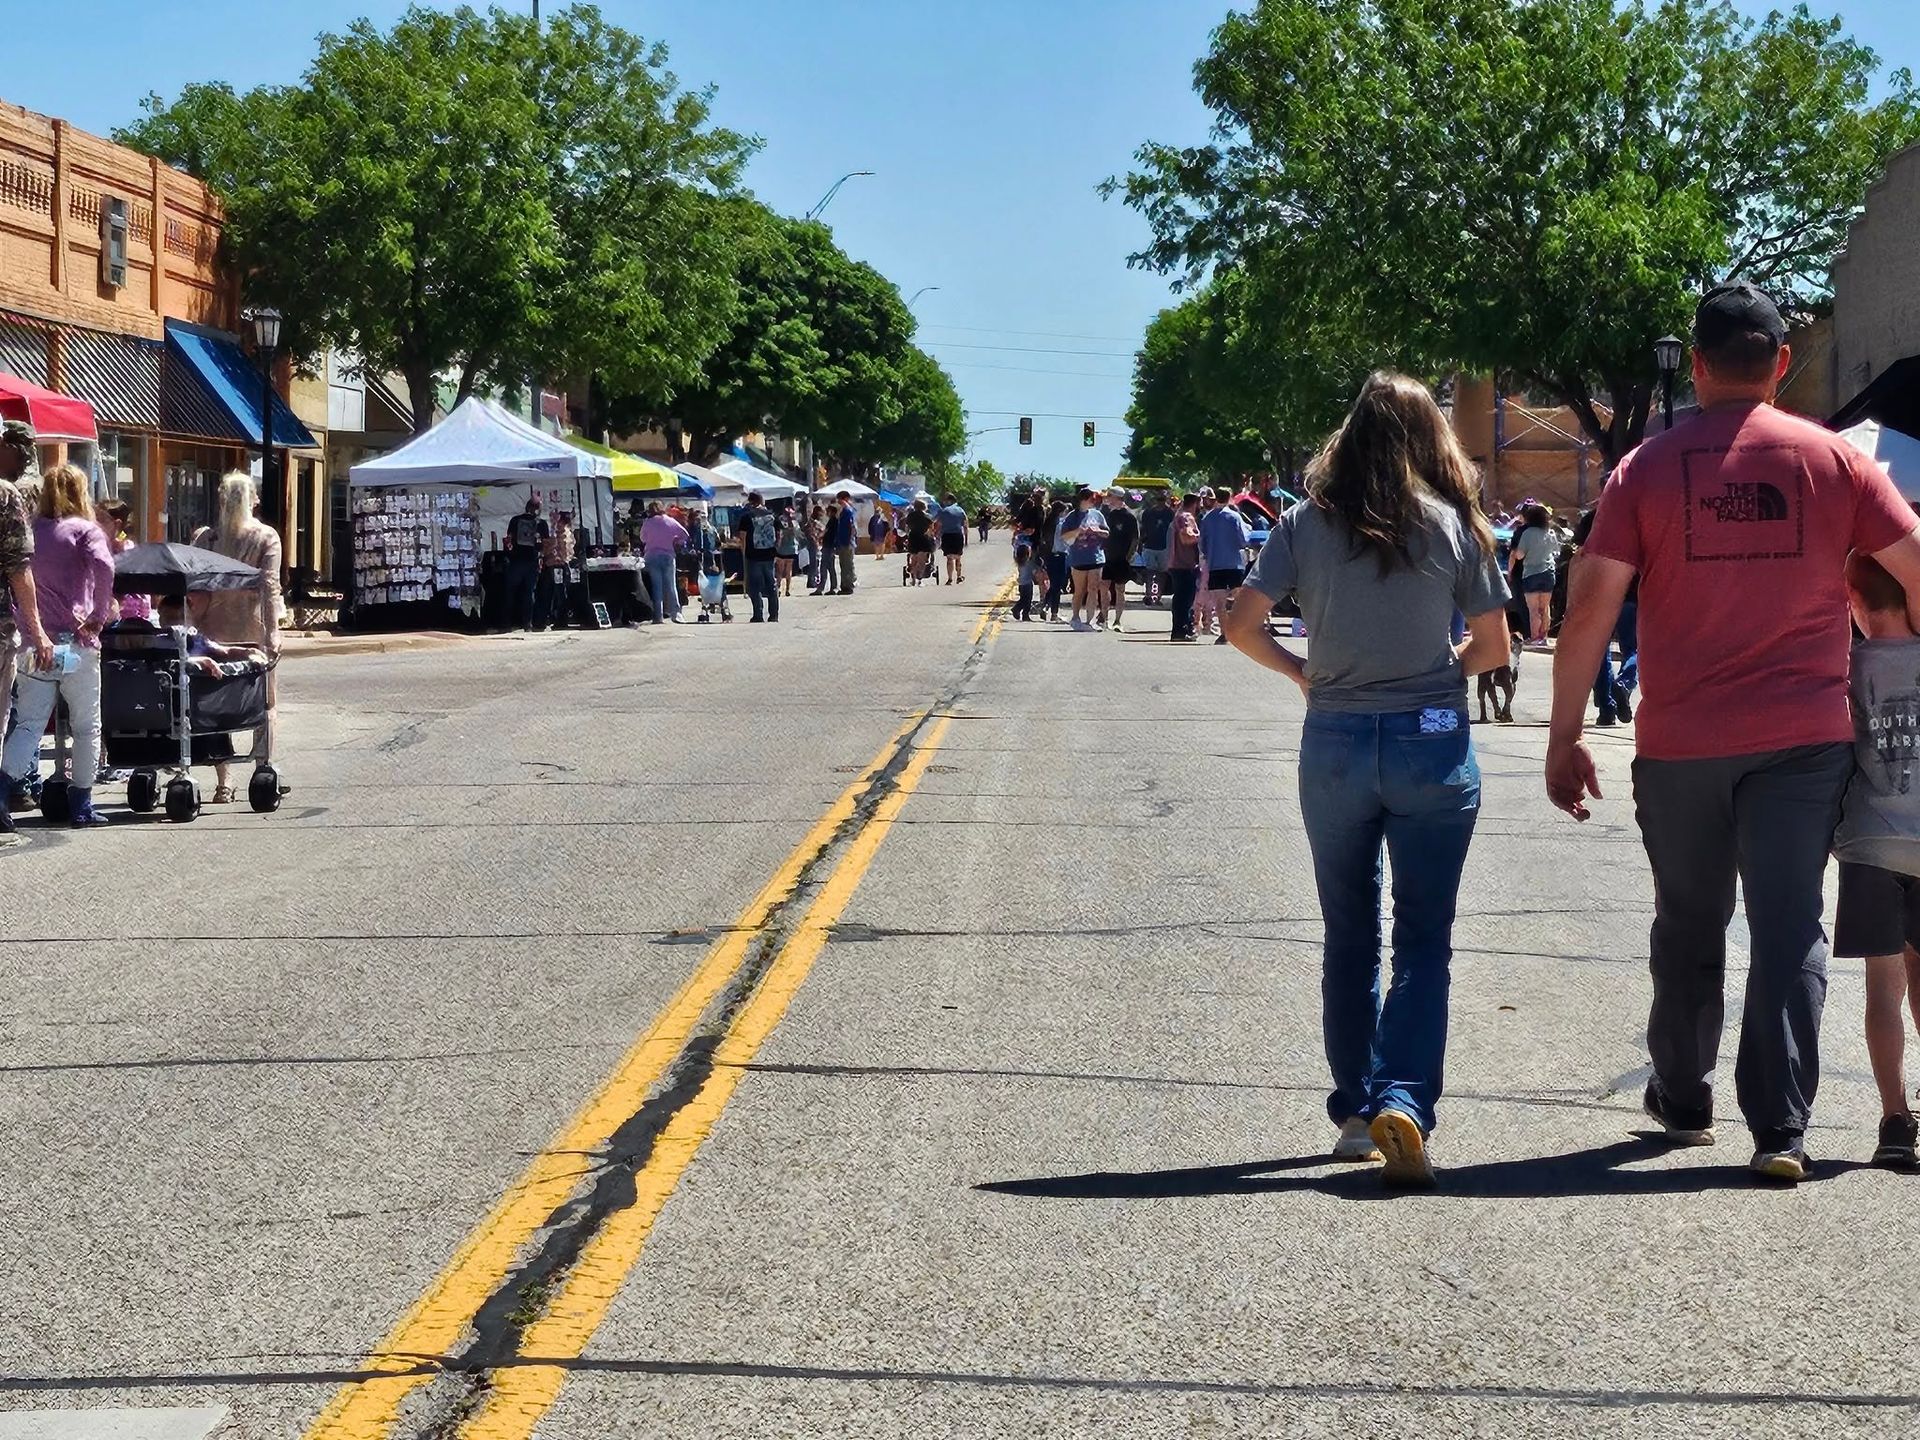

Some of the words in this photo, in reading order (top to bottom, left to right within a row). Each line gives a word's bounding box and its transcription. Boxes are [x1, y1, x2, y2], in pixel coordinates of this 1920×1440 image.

[1723, 482, 1756, 496] THE
[1700, 495, 1756, 510] NORTH
[1717, 508, 1756, 522] FACE
